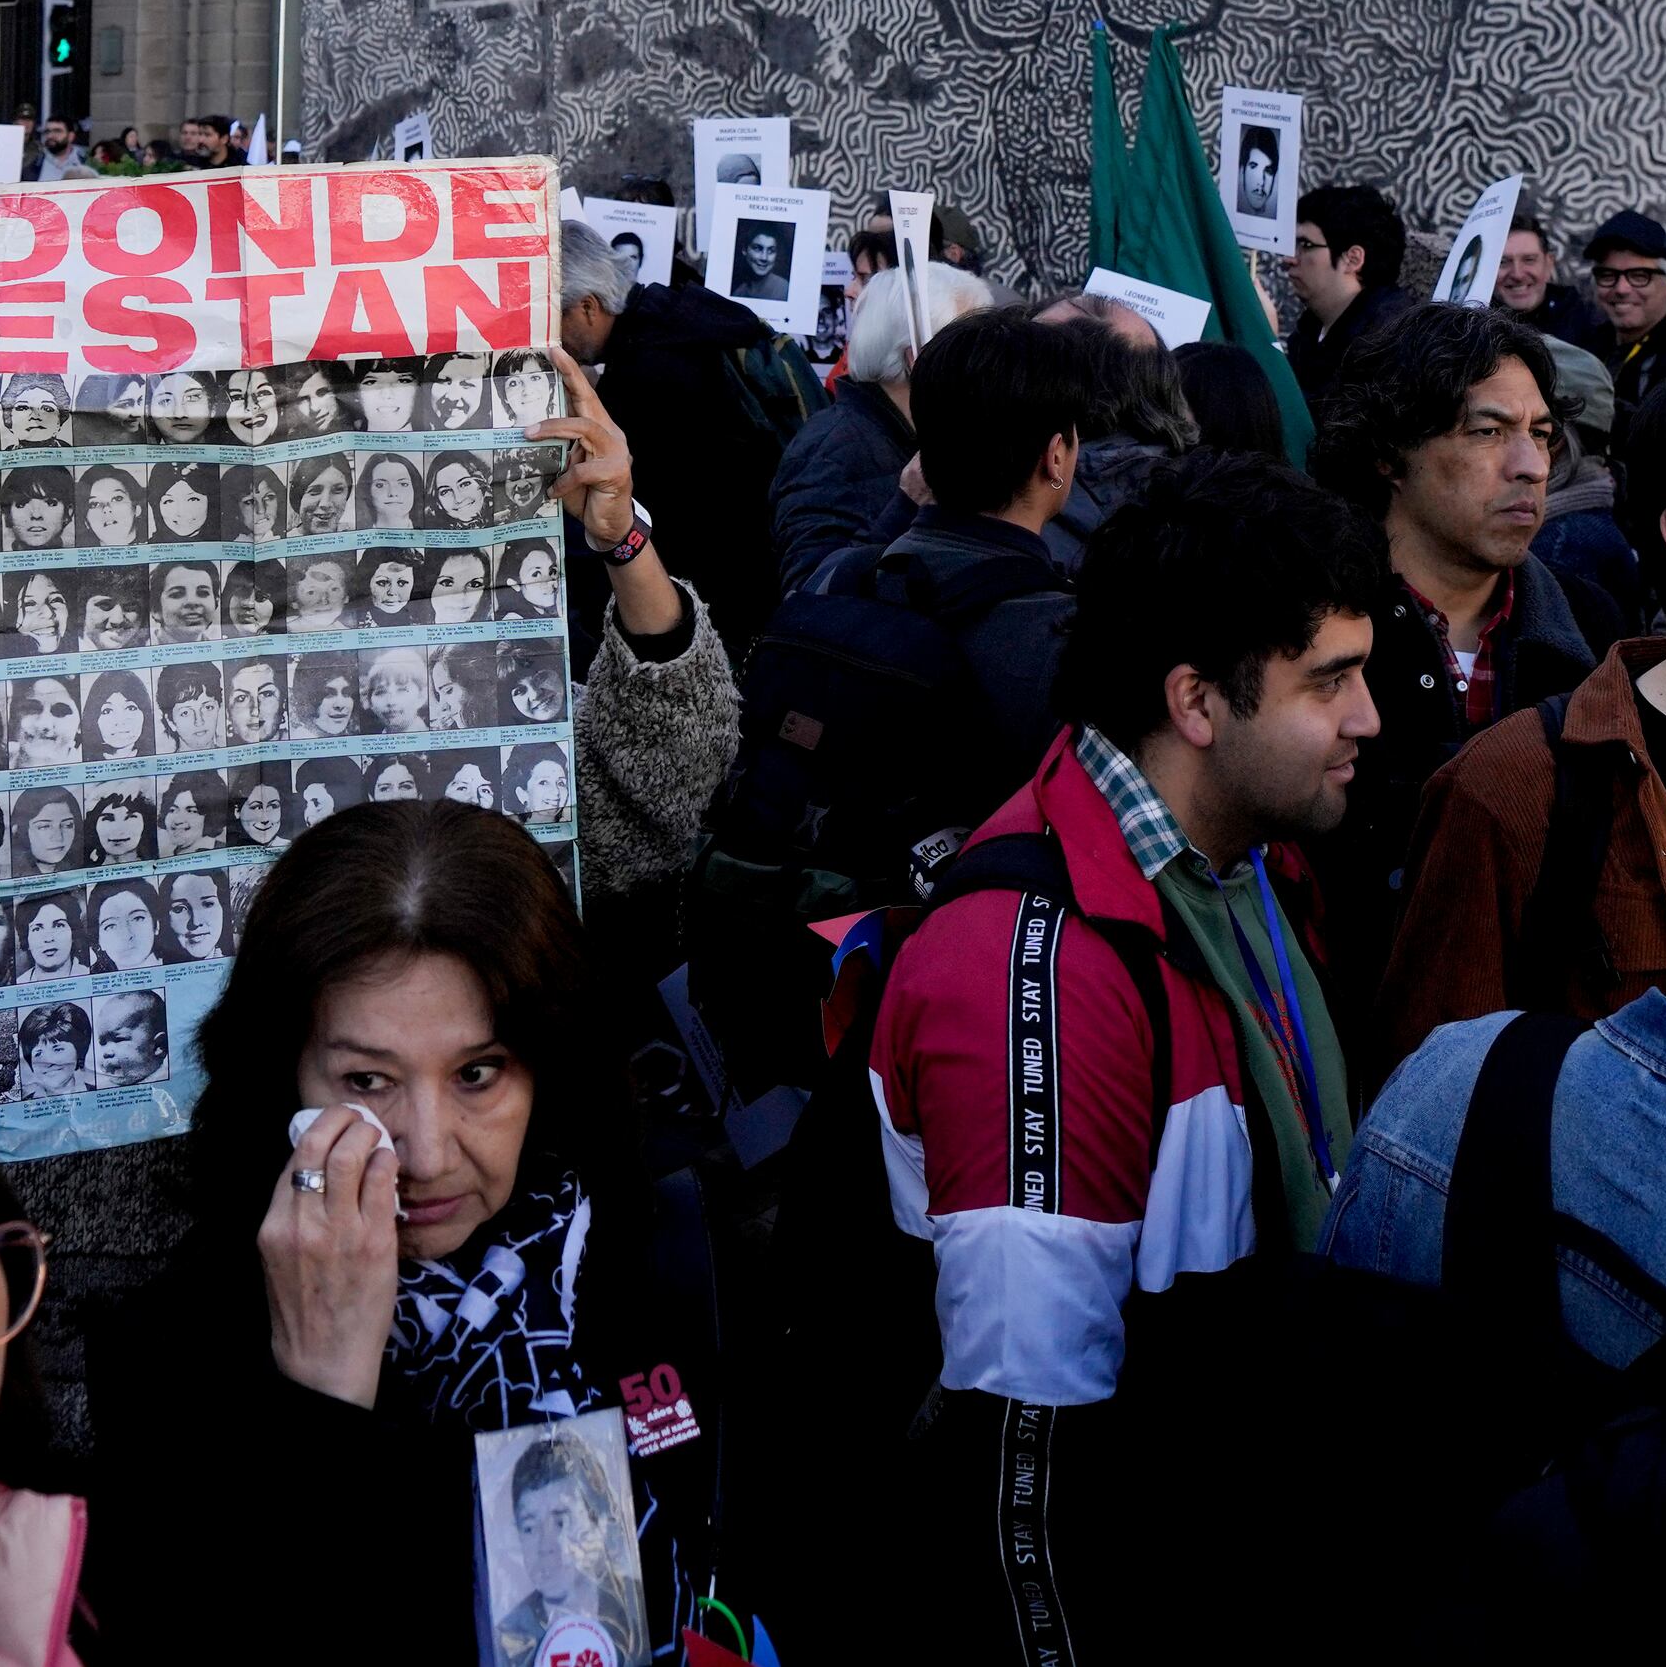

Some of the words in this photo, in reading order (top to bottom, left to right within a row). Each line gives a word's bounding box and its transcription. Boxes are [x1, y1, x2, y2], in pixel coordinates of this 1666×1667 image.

[734, 194, 770, 203] ELIZABETH
[770, 196, 804, 206] MERCEDES
[770, 204, 788, 213] URRA
[1124, 289, 1159, 306] LEOMERES
[1140, 304, 1166, 320] SEGUEL
[1022, 918, 1046, 966] TUNED
[1022, 978, 1041, 1023] STAY
[1023, 1037, 1044, 1095] TUNED
[1024, 1108, 1045, 1156] STAY
[619, 1362, 682, 1415] 50
[647, 1405, 673, 1423] Años
[660, 1426, 671, 1437] ni
[671, 1417, 696, 1433] nadie
[1017, 1402, 1041, 1443] STA
[659, 1426, 701, 1449] olvidado!
[1013, 1451, 1035, 1507] TUNED
[1012, 1519, 1036, 1565] STAY
[1021, 1580, 1053, 1633] TUNED
